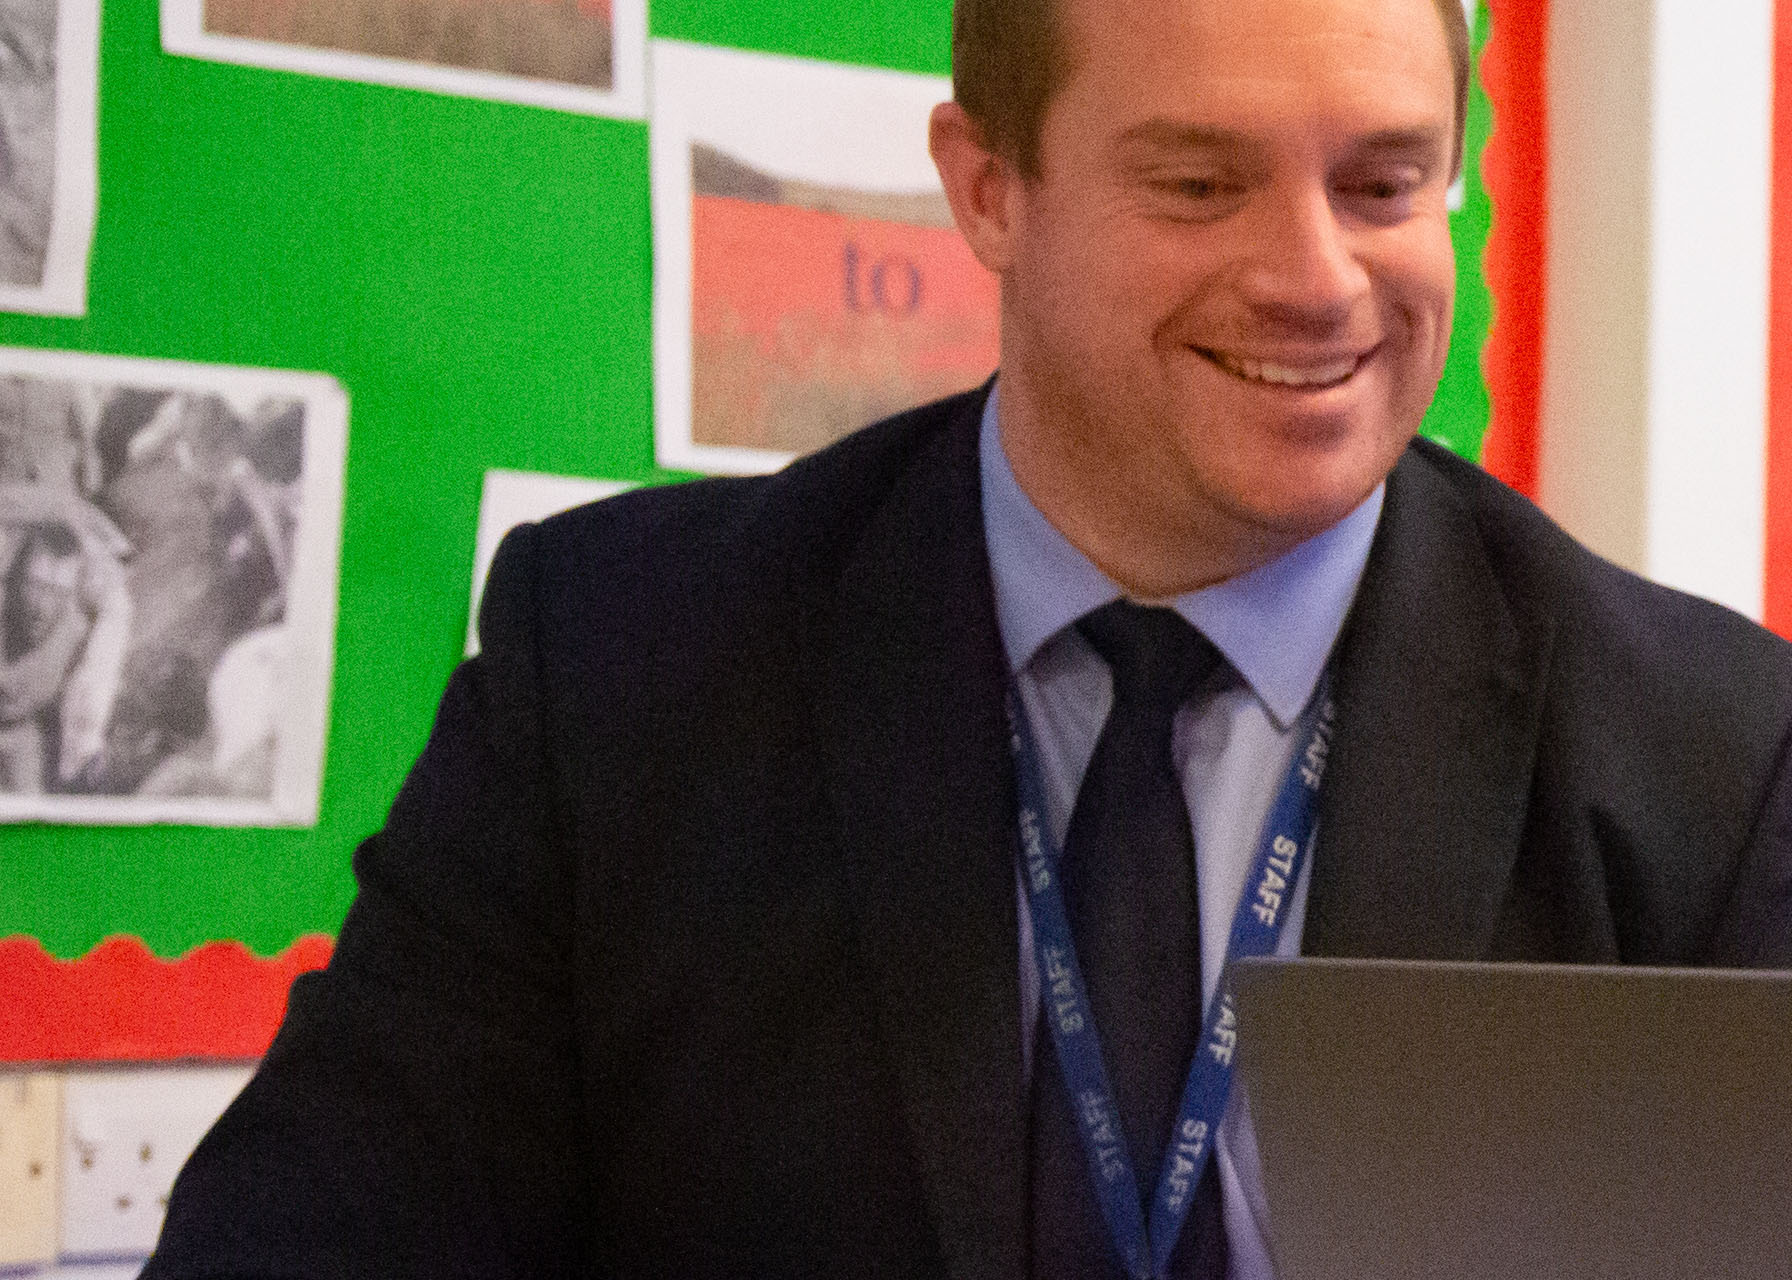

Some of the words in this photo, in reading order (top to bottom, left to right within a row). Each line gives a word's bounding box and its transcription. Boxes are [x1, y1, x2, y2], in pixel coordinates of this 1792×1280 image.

[842, 240, 923, 317] to
[1253, 833, 1298, 927] STAFF
[1043, 945, 1084, 1036] STAFF
[1079, 1089, 1124, 1184] STAFF
[1165, 1118, 1209, 1213] STAFF
